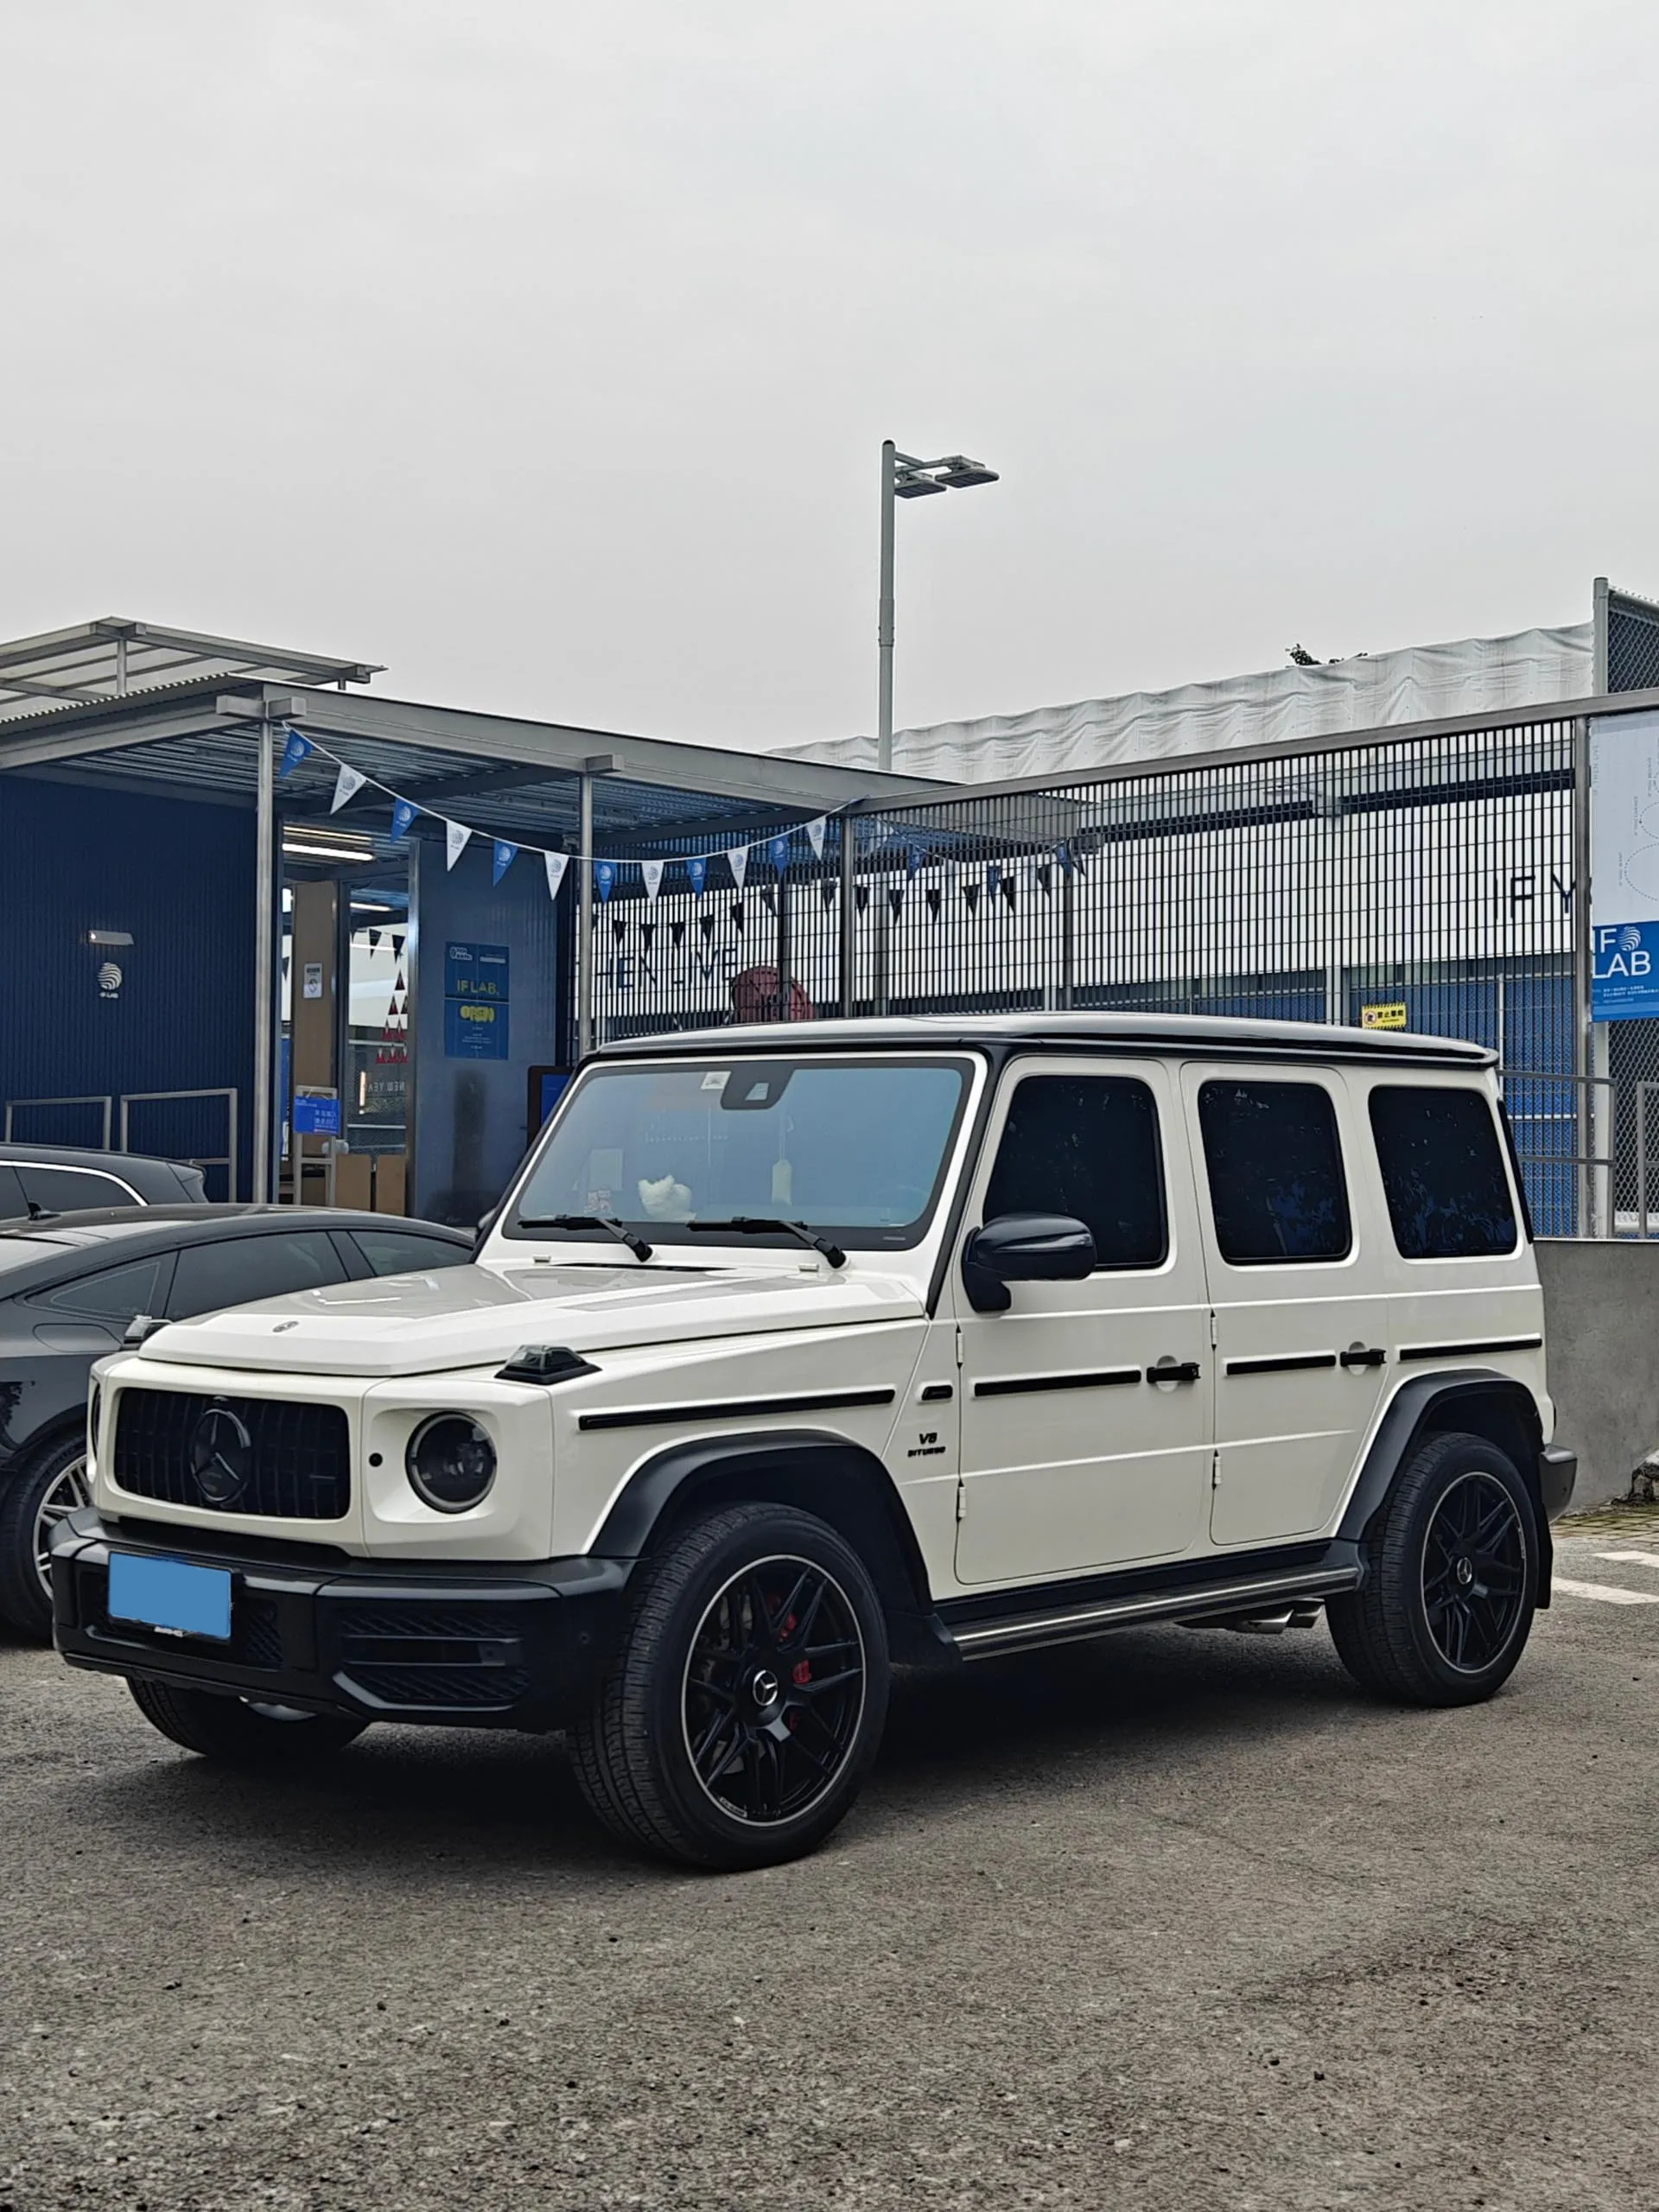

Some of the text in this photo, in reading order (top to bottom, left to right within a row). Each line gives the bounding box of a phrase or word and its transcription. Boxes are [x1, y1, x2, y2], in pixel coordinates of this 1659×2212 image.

[1592, 927, 1618, 954] IF
[1592, 950, 1651, 980] LAB
[919, 1432, 938, 1445] V8
